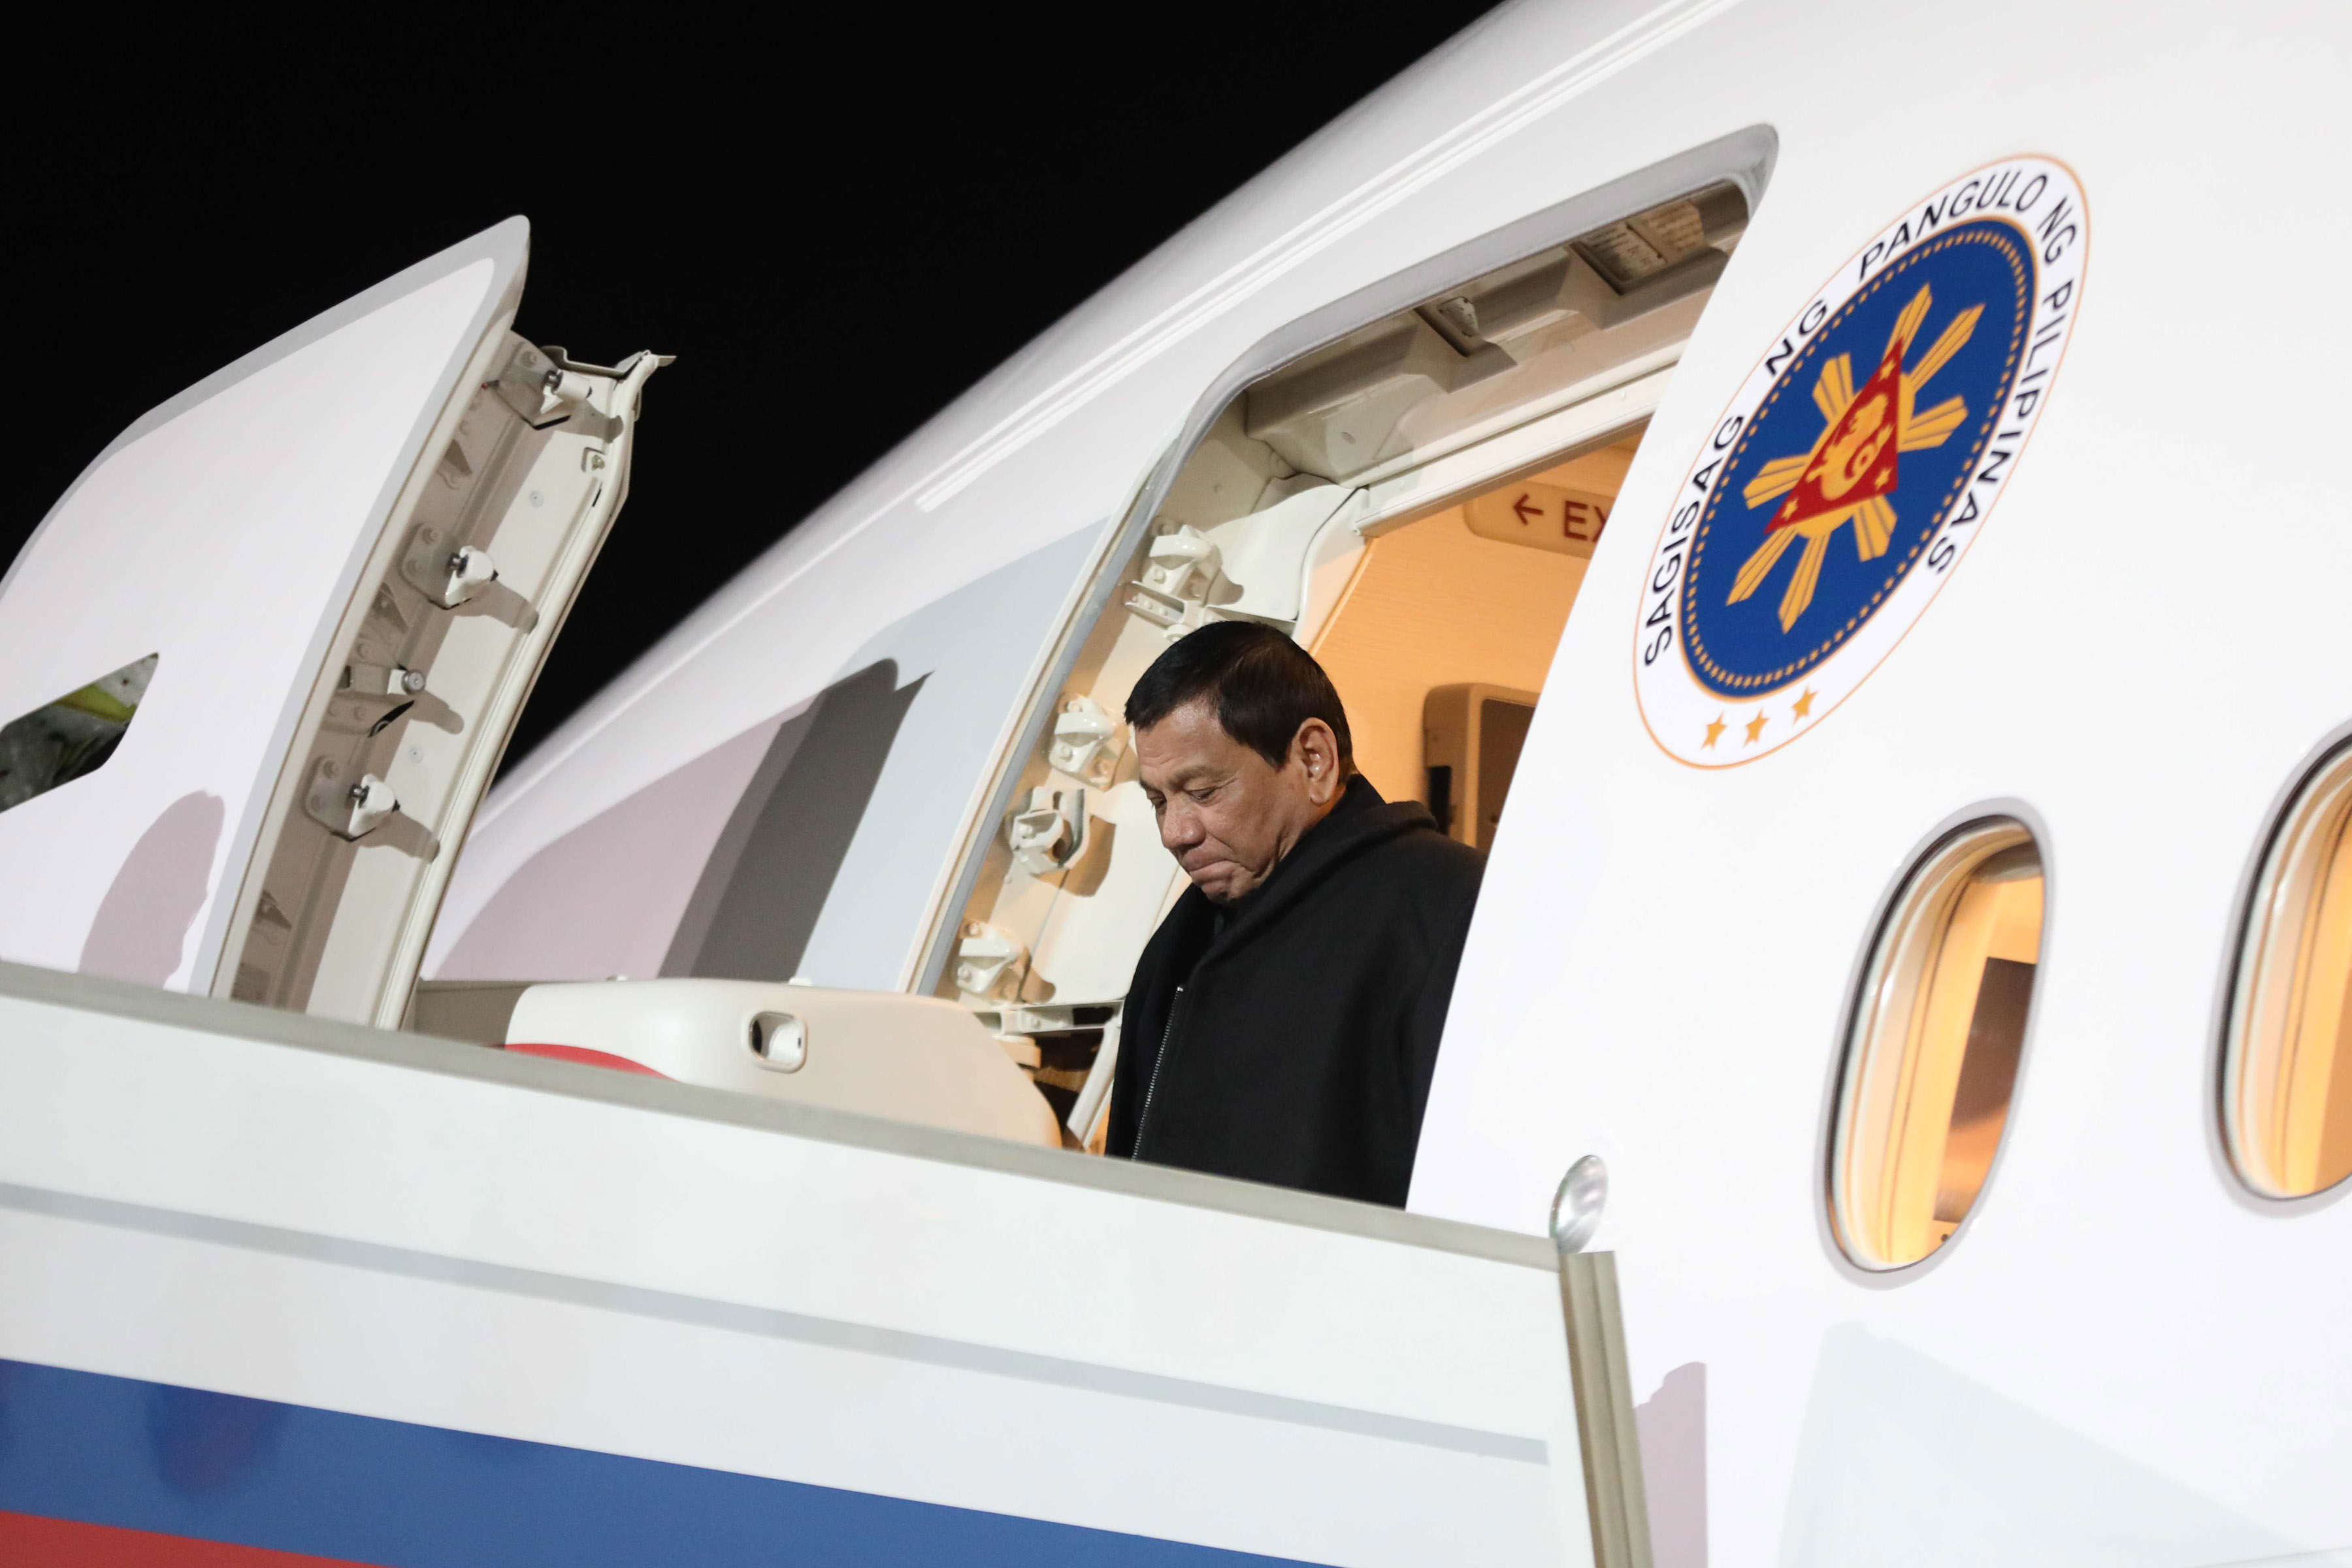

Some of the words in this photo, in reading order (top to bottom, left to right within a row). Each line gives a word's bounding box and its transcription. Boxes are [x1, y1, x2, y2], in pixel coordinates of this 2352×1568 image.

[1857, 168, 2049, 283] PANGULO
[2036, 195, 2078, 267] NG
[1764, 298, 1828, 378] NG
[1925, 278, 2075, 575] PILIPINAS
[1644, 413, 1746, 668] SAGISAG
